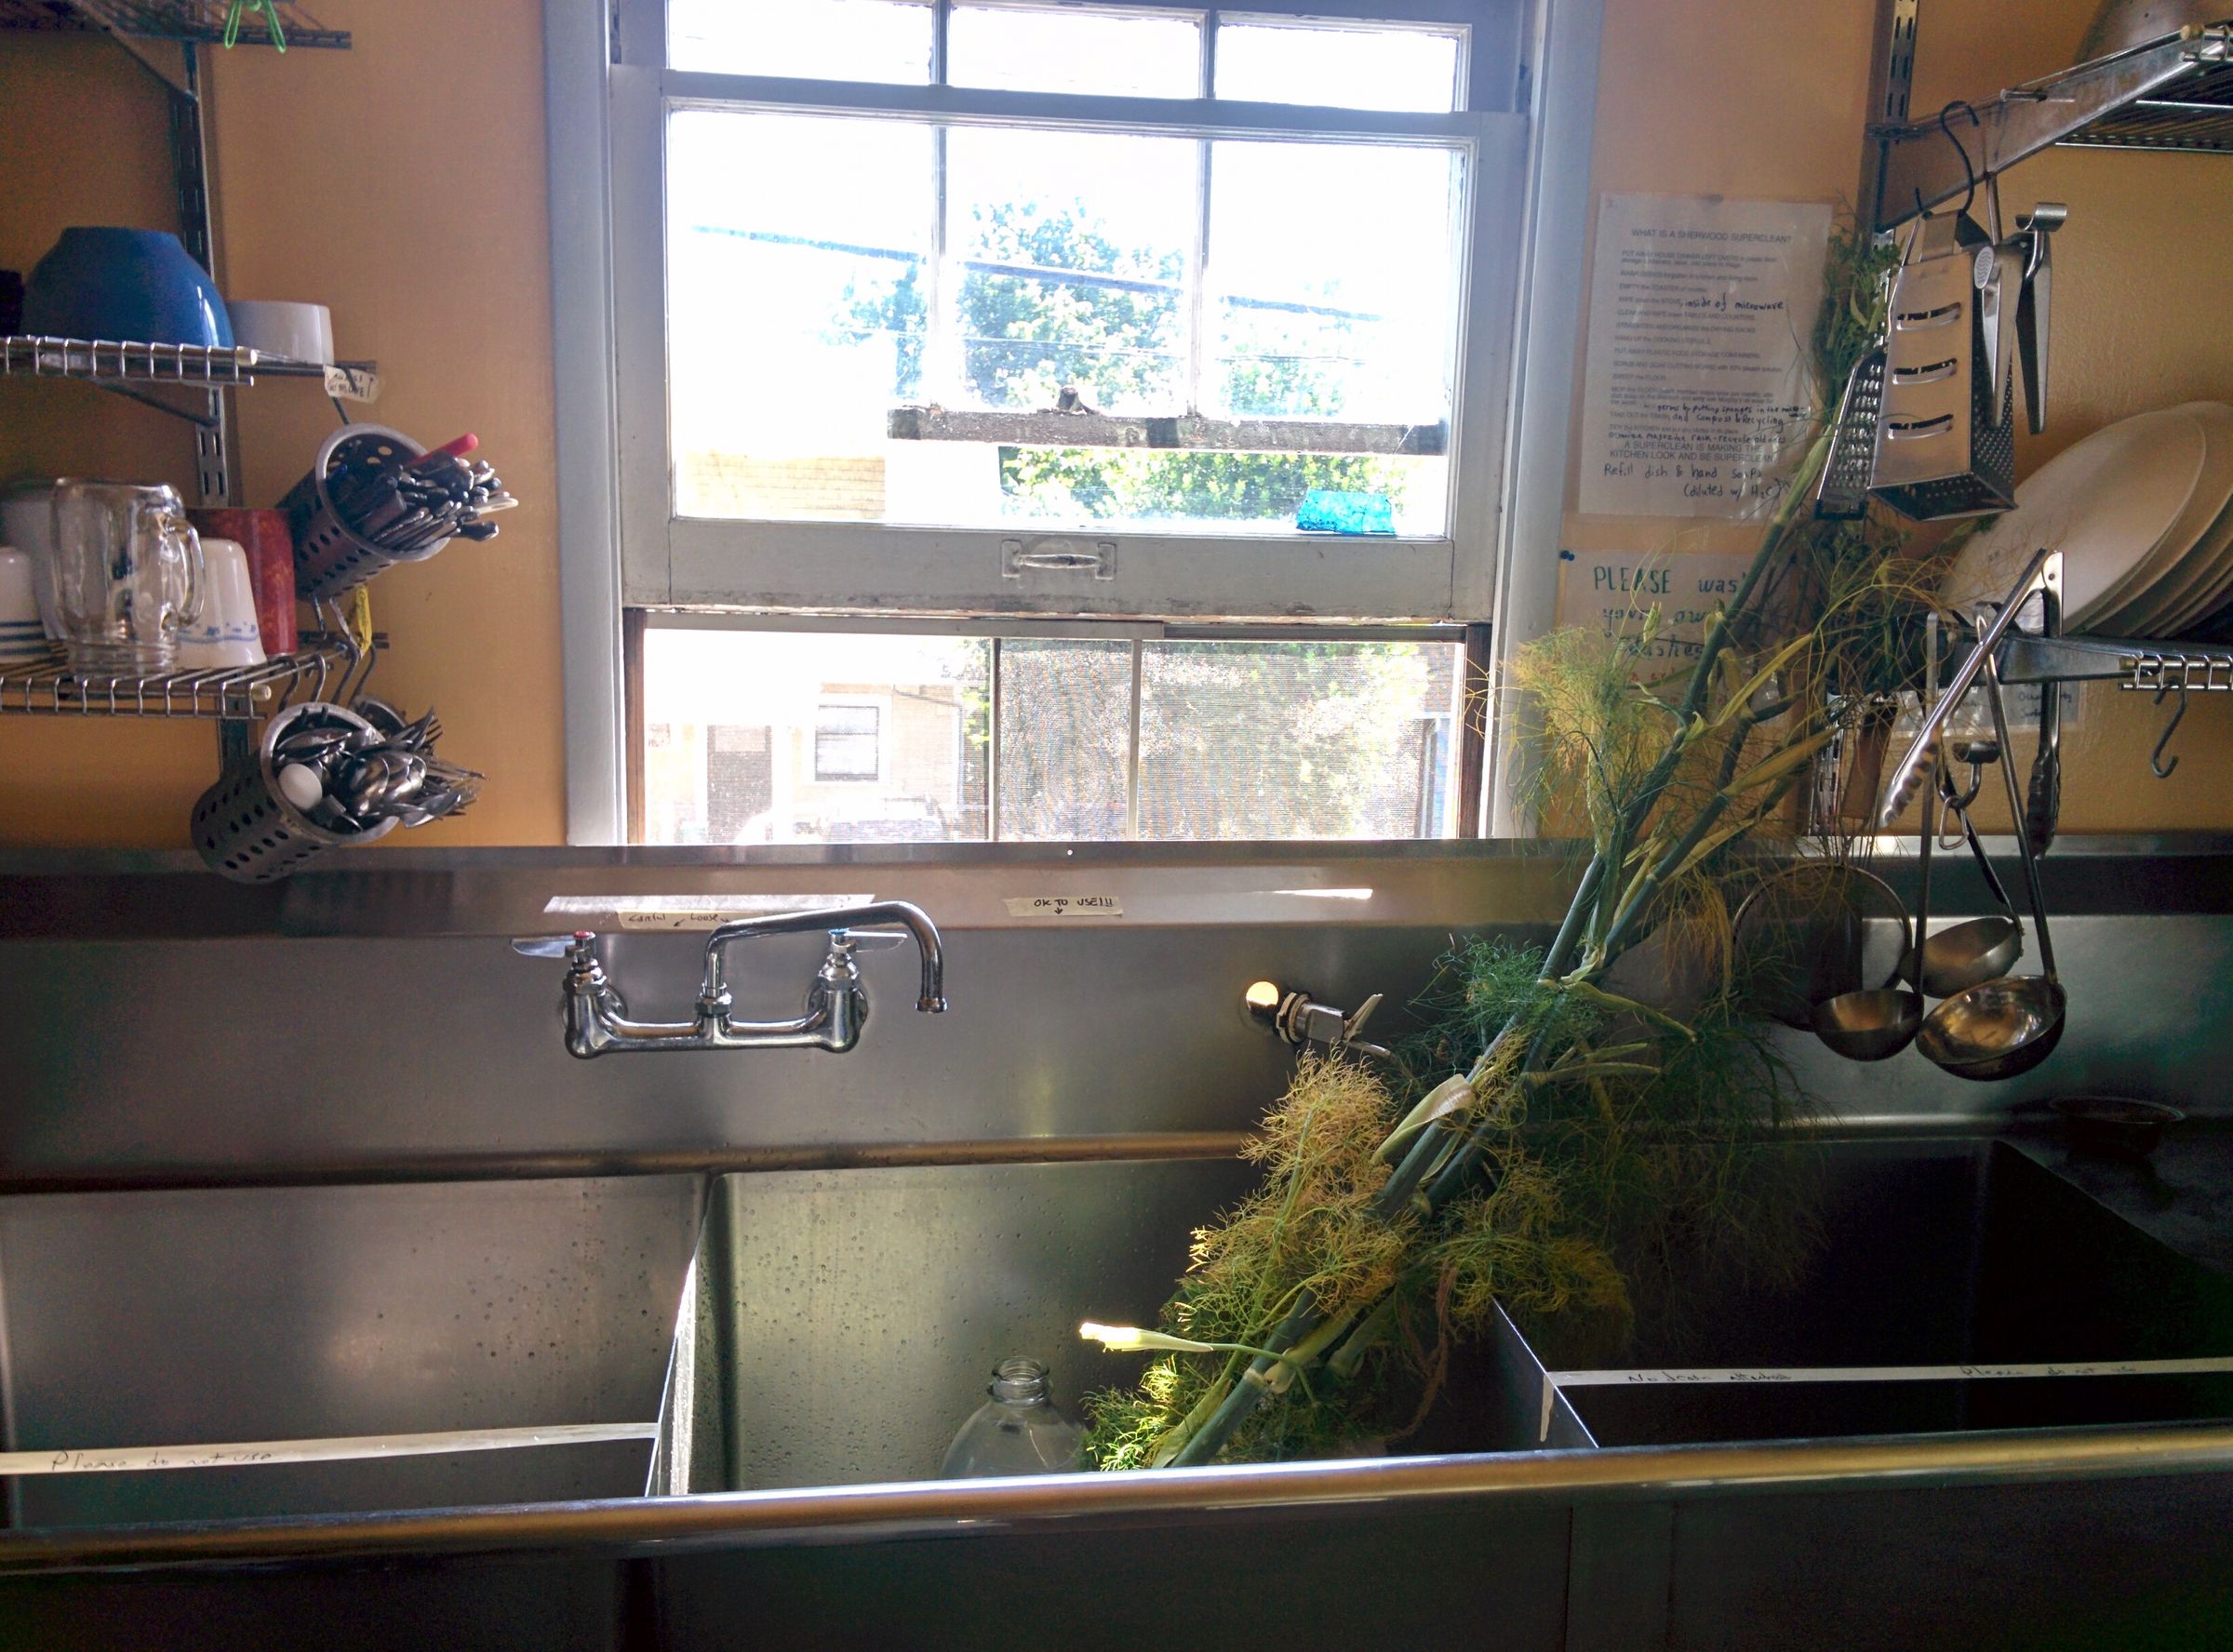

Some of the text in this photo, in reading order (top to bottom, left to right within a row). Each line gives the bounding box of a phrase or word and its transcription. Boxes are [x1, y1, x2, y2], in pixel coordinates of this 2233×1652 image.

[1632, 229, 1655, 237] WHAT
[1659, 230, 1667, 238] IS
[1678, 231, 1728, 240] SHERWOOD
[1685, 292, 1785, 312] inside of microwave
[1681, 402, 1691, 415] by
[1721, 406, 1753, 414] sponges
[1672, 414, 1689, 422] and
[1624, 441, 1764, 454] A SUPERCLEAN IS MAKING THE
[1610, 449, 1649, 460] KITCHEN
[1651, 450, 1676, 460] LOOK
[1678, 452, 1698, 461] AND
[1700, 453, 1712, 462] BE
[1604, 465, 1633, 476] Refill
[1645, 465, 1668, 478] dish
[1676, 465, 1684, 477] &
[1691, 464, 1718, 478] hand
[1683, 483, 1723, 498] (diluted
[1594, 566, 1747, 593] PLEASE was
[1034, 899, 1052, 907] OK
[628, 913, 666, 923] Careful
[1628, 1373, 1659, 1382] No
[52, 1449, 273, 1471] Please do not use
